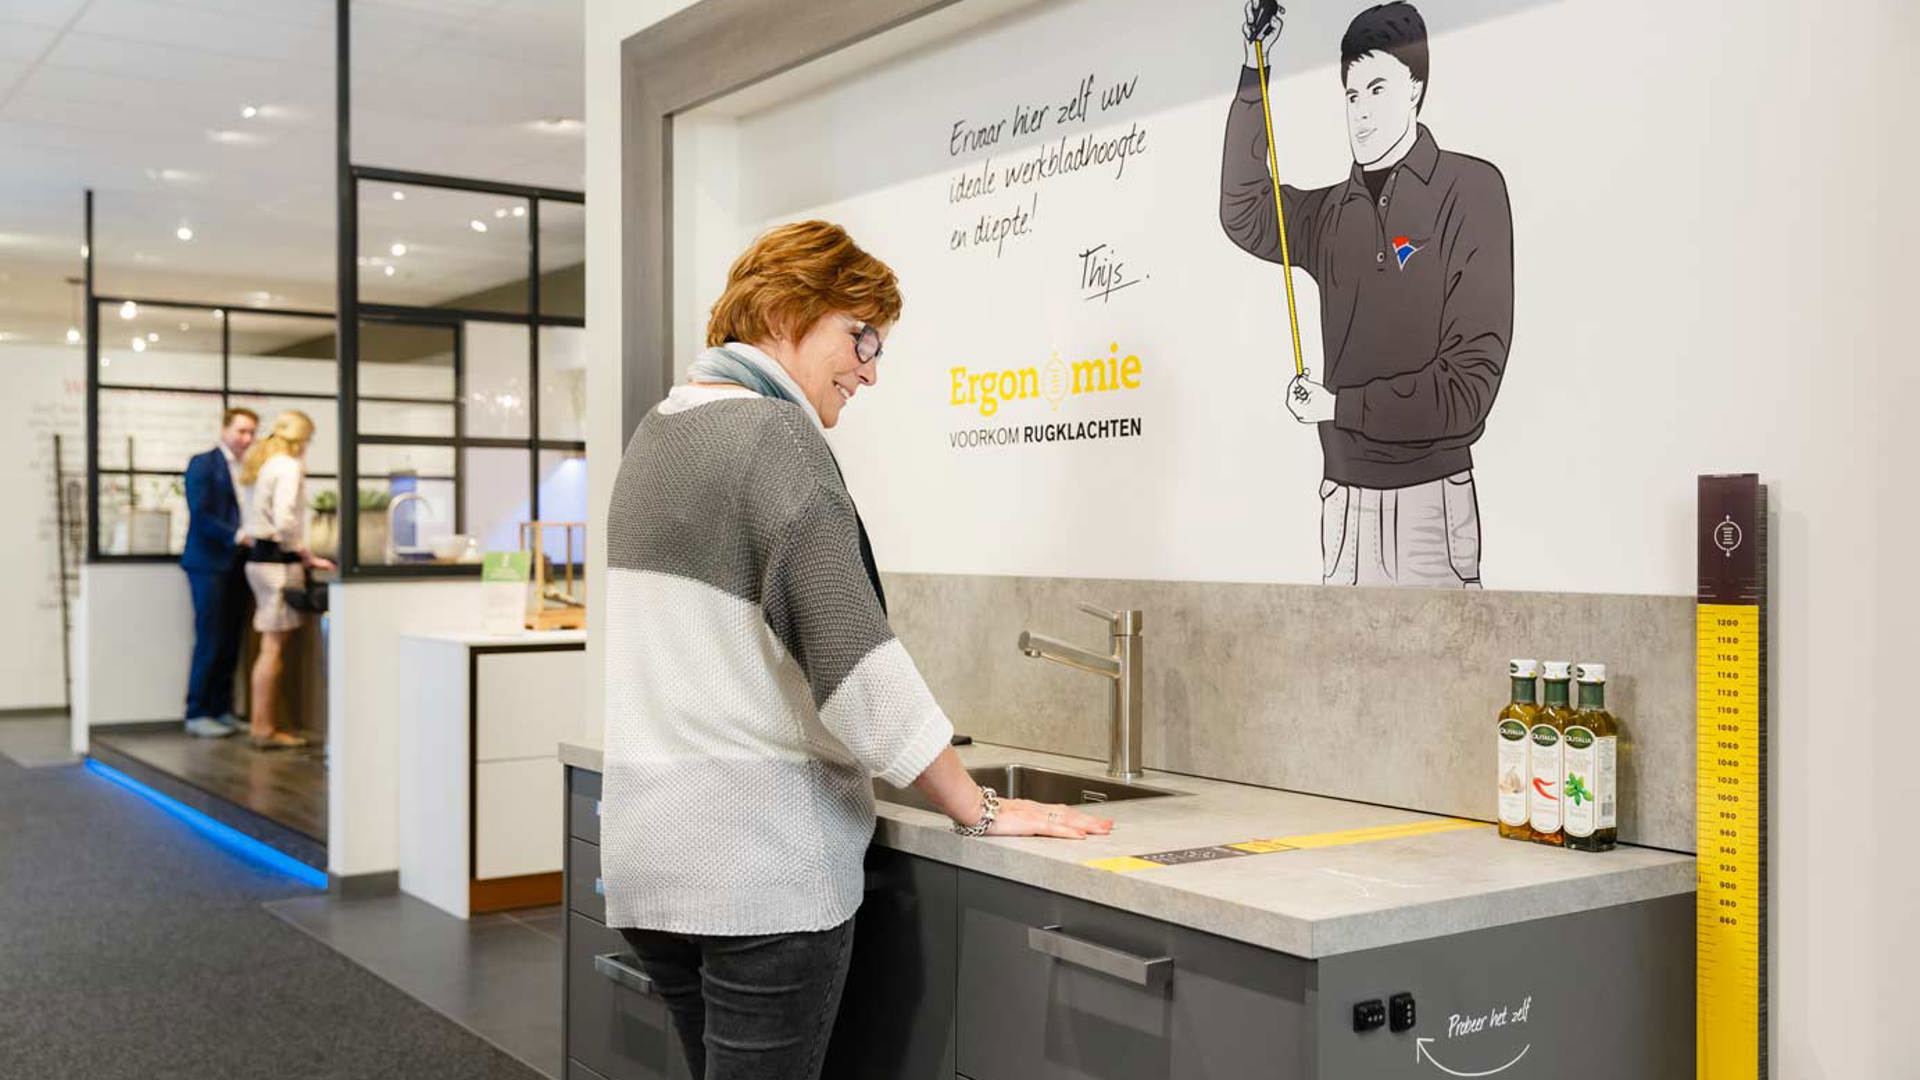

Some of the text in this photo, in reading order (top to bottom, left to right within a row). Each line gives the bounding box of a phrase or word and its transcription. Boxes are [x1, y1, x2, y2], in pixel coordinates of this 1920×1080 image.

[950, 73, 1139, 156] Ervaar hier zelf uw
[949, 122, 1148, 204] ideale werkbladhoogte
[950, 193, 1038, 257] en diepte!
[950, 417, 1142, 449] VOORKOM RUGKLACHTEN
[1717, 619, 1739, 627] 1200
[1717, 636, 1739, 644] 1180
[1717, 654, 1739, 662] 1160
[1717, 671, 1739, 679] 1140
[1717, 689, 1739, 697] 1120
[1717, 706, 1739, 714] 1100
[1717, 724, 1739, 732] 1080
[1717, 741, 1739, 750] 1060
[1717, 759, 1739, 767] 1040
[1717, 776, 1739, 785] 1020
[1717, 794, 1739, 802] 1000
[1719, 864, 1737, 872] 920
[1719, 881, 1737, 890] 900
[1448, 995, 1532, 1039] Probeer het zelf
